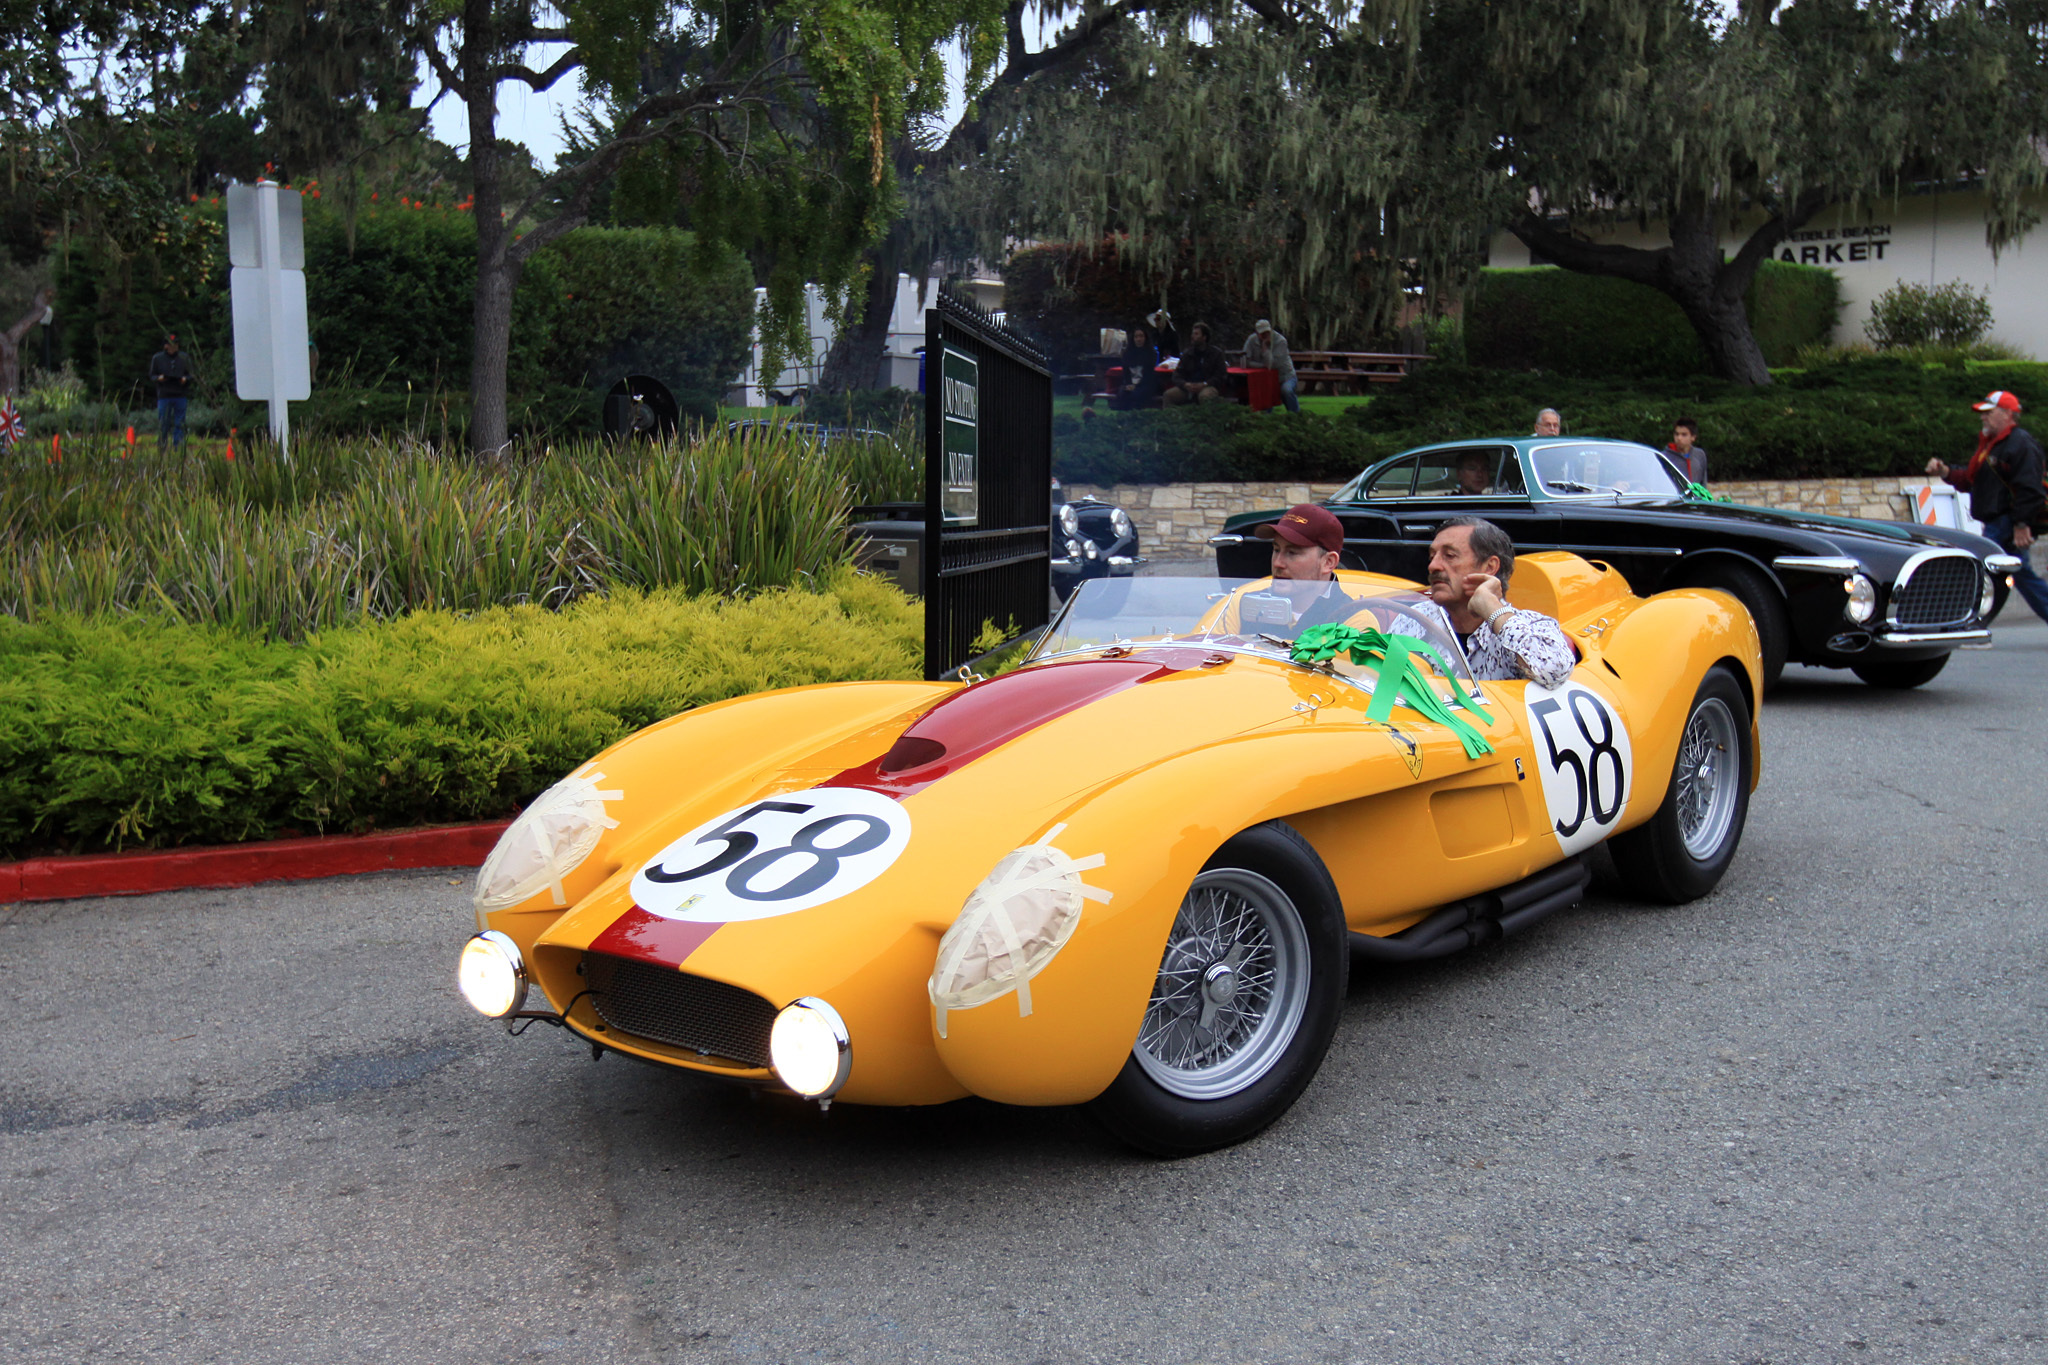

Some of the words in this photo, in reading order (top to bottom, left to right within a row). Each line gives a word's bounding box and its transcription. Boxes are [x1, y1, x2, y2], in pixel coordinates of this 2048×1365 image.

[1842, 224, 1891, 238] BEACH
[1772, 240, 1890, 264] ARKET
[945, 376, 954, 414] NO
[948, 451, 957, 486] NO
[1528, 689, 1625, 838] 58
[644, 801, 891, 902] 58
